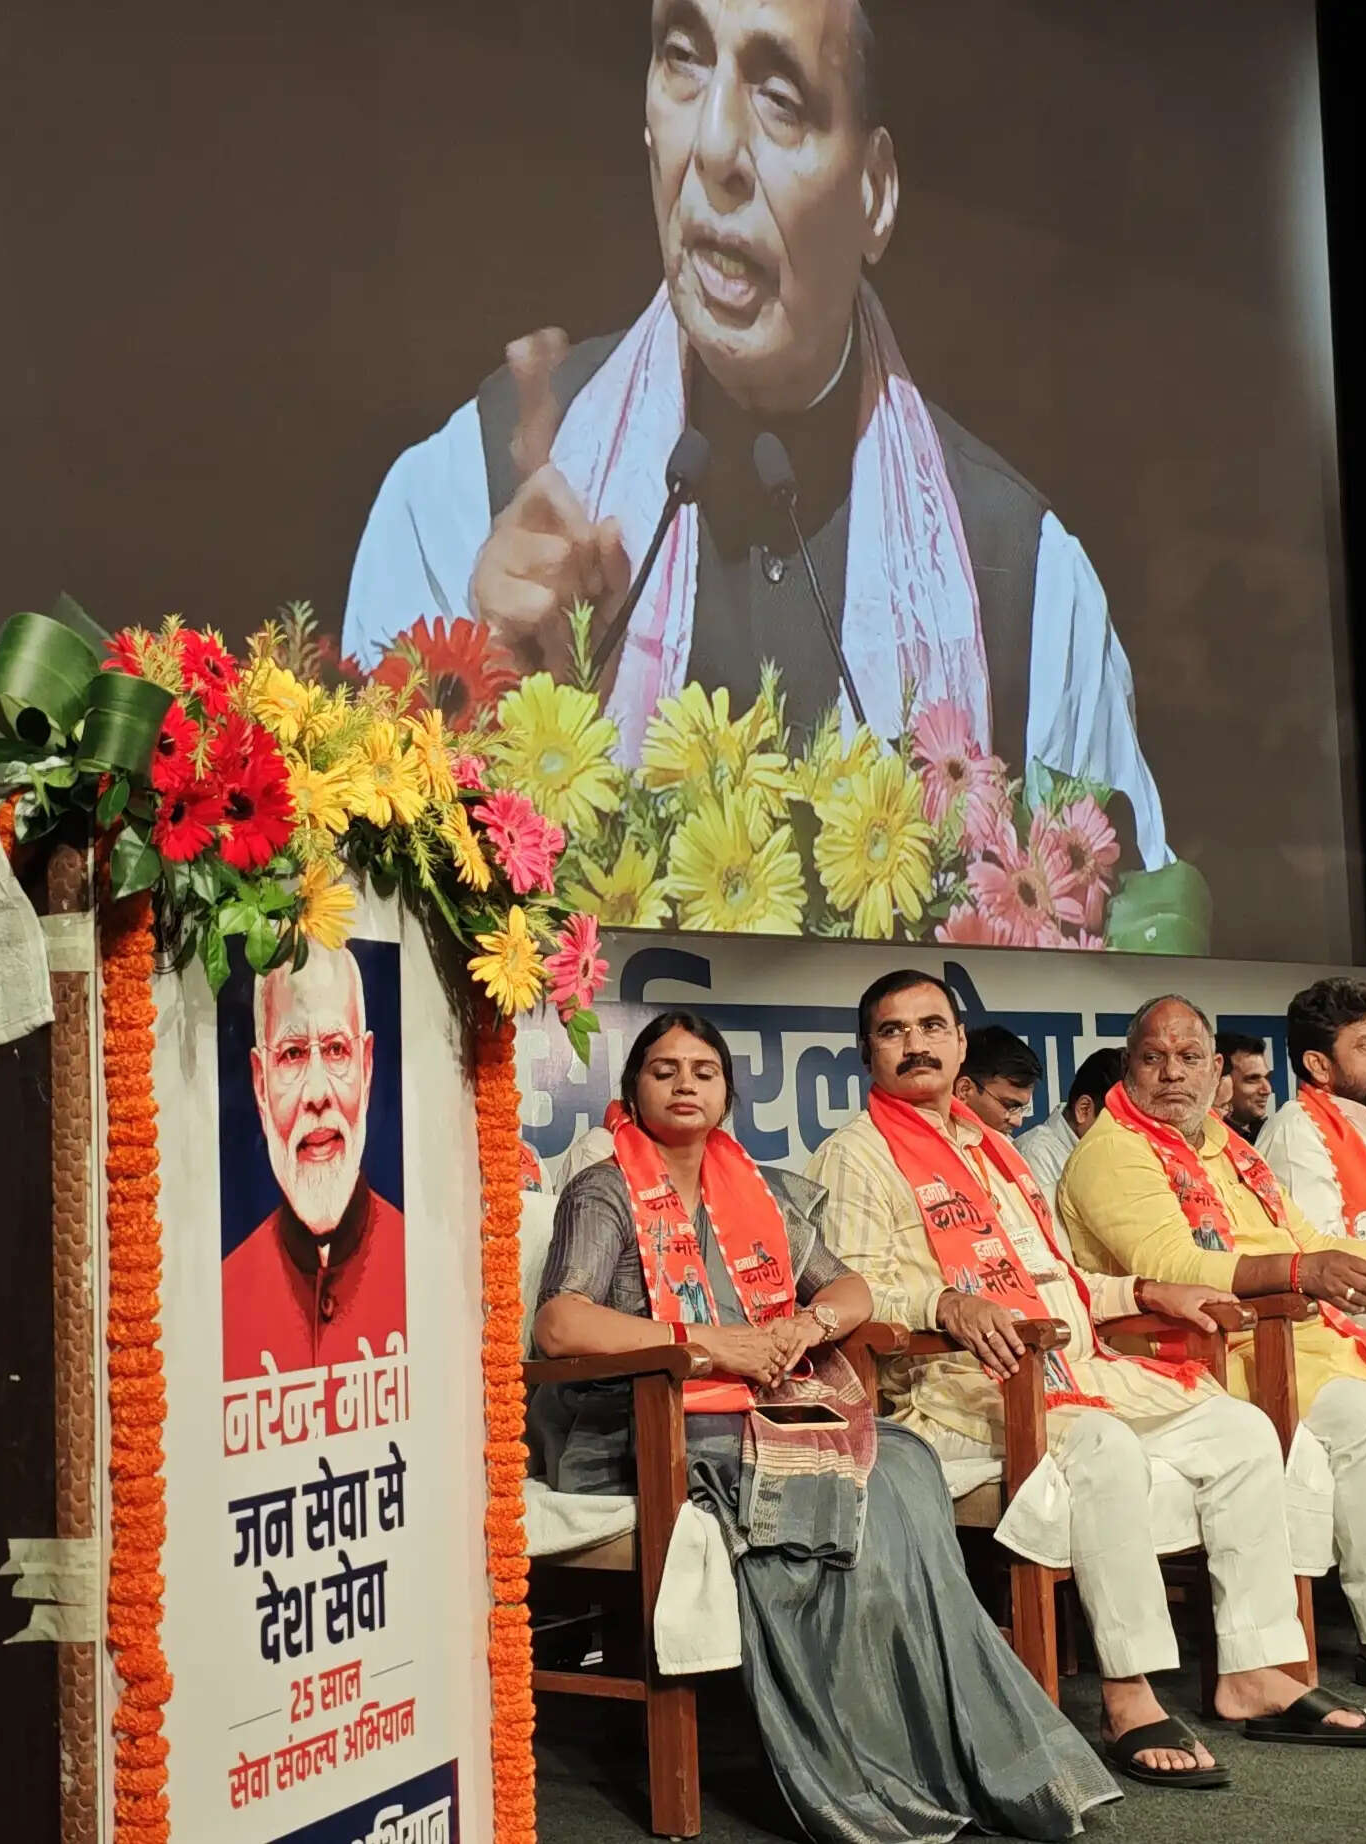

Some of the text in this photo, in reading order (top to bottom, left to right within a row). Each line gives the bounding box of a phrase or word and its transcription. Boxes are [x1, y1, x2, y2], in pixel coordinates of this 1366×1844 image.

[332, 1331, 409, 1430] मोदी
[228, 1441, 406, 1568] जन सेवा से
[256, 1550, 388, 1664] देश सेवा
[290, 1659, 363, 1723] 25 साल
[228, 1697, 415, 1809] सेवा संकल्प अभियान
